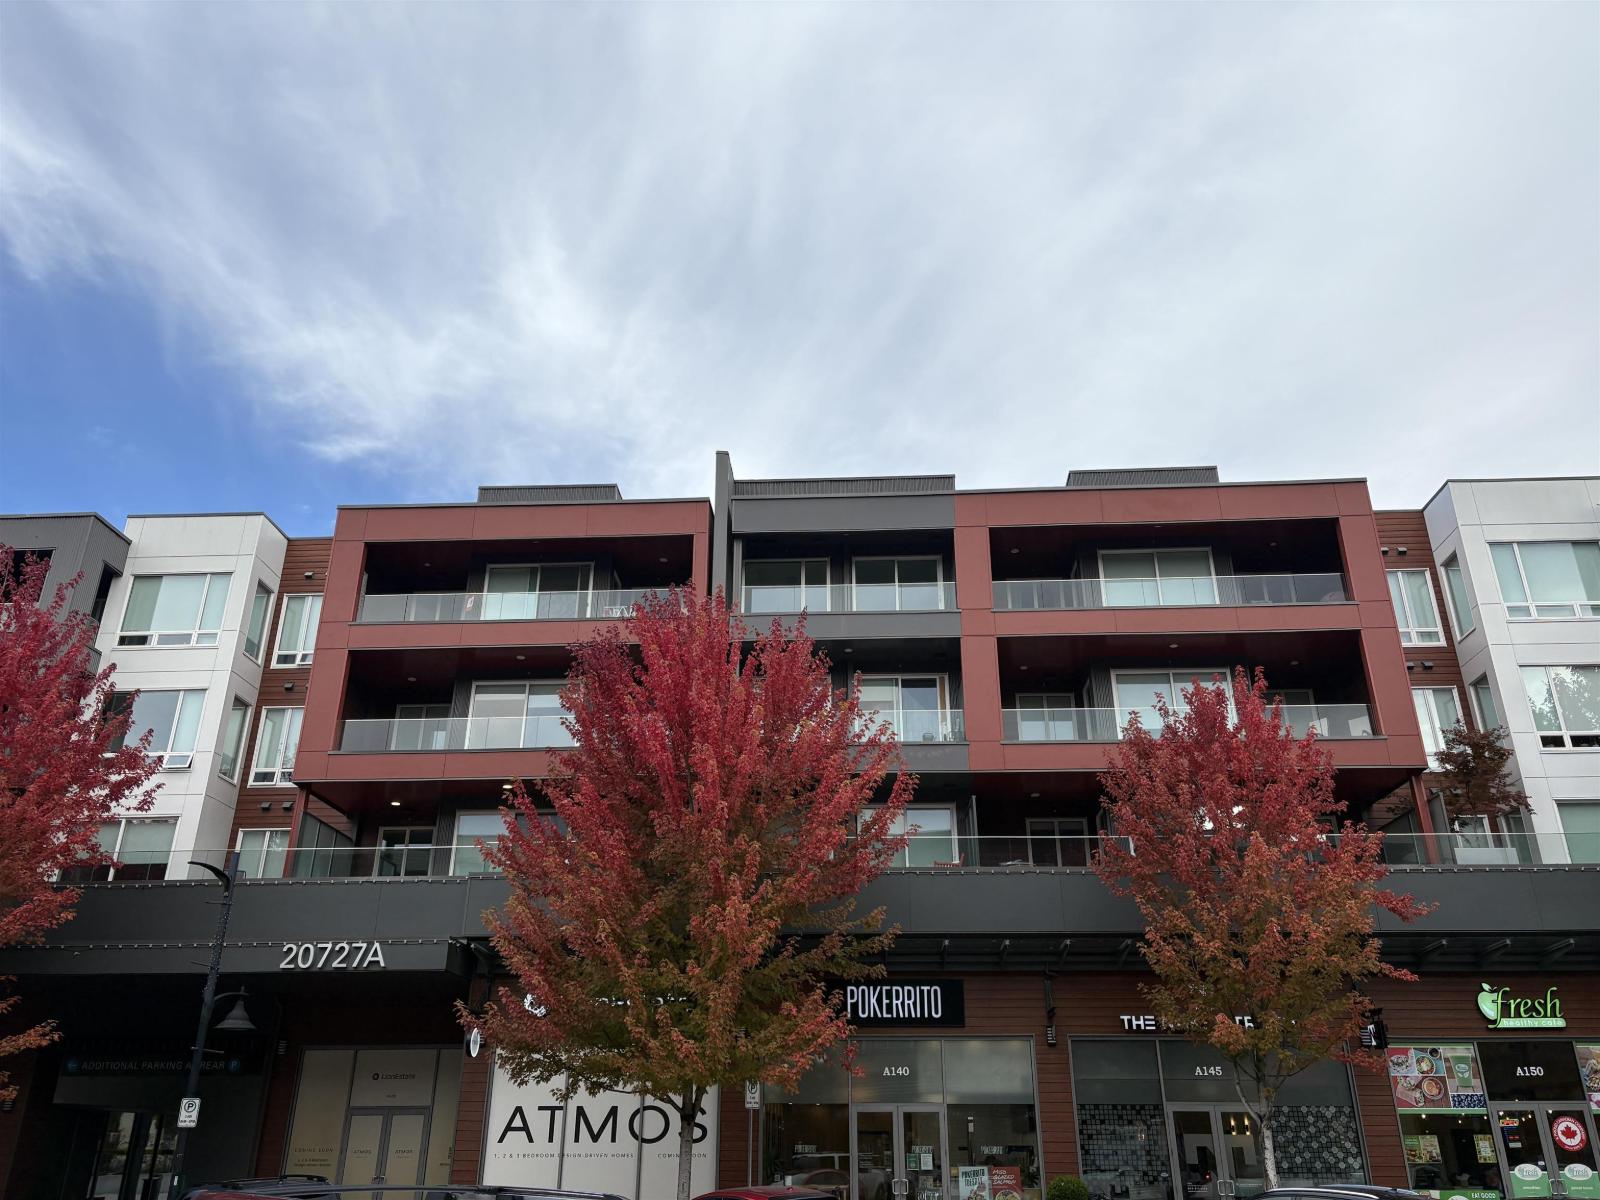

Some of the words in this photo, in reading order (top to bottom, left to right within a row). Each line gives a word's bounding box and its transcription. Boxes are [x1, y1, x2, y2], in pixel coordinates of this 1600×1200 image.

[280, 942, 386, 969] 20727A
[847, 985, 942, 1018] POKERRITO
[1488, 987, 1564, 1028] fresh
[1120, 1015, 1156, 1030] THE
[81, 1061, 140, 1071] ADDITIONAL
[142, 1061, 184, 1071] PARKING
[883, 1066, 910, 1076] A140
[1195, 1066, 1223, 1076] A145
[1516, 1067, 1544, 1076] A150
